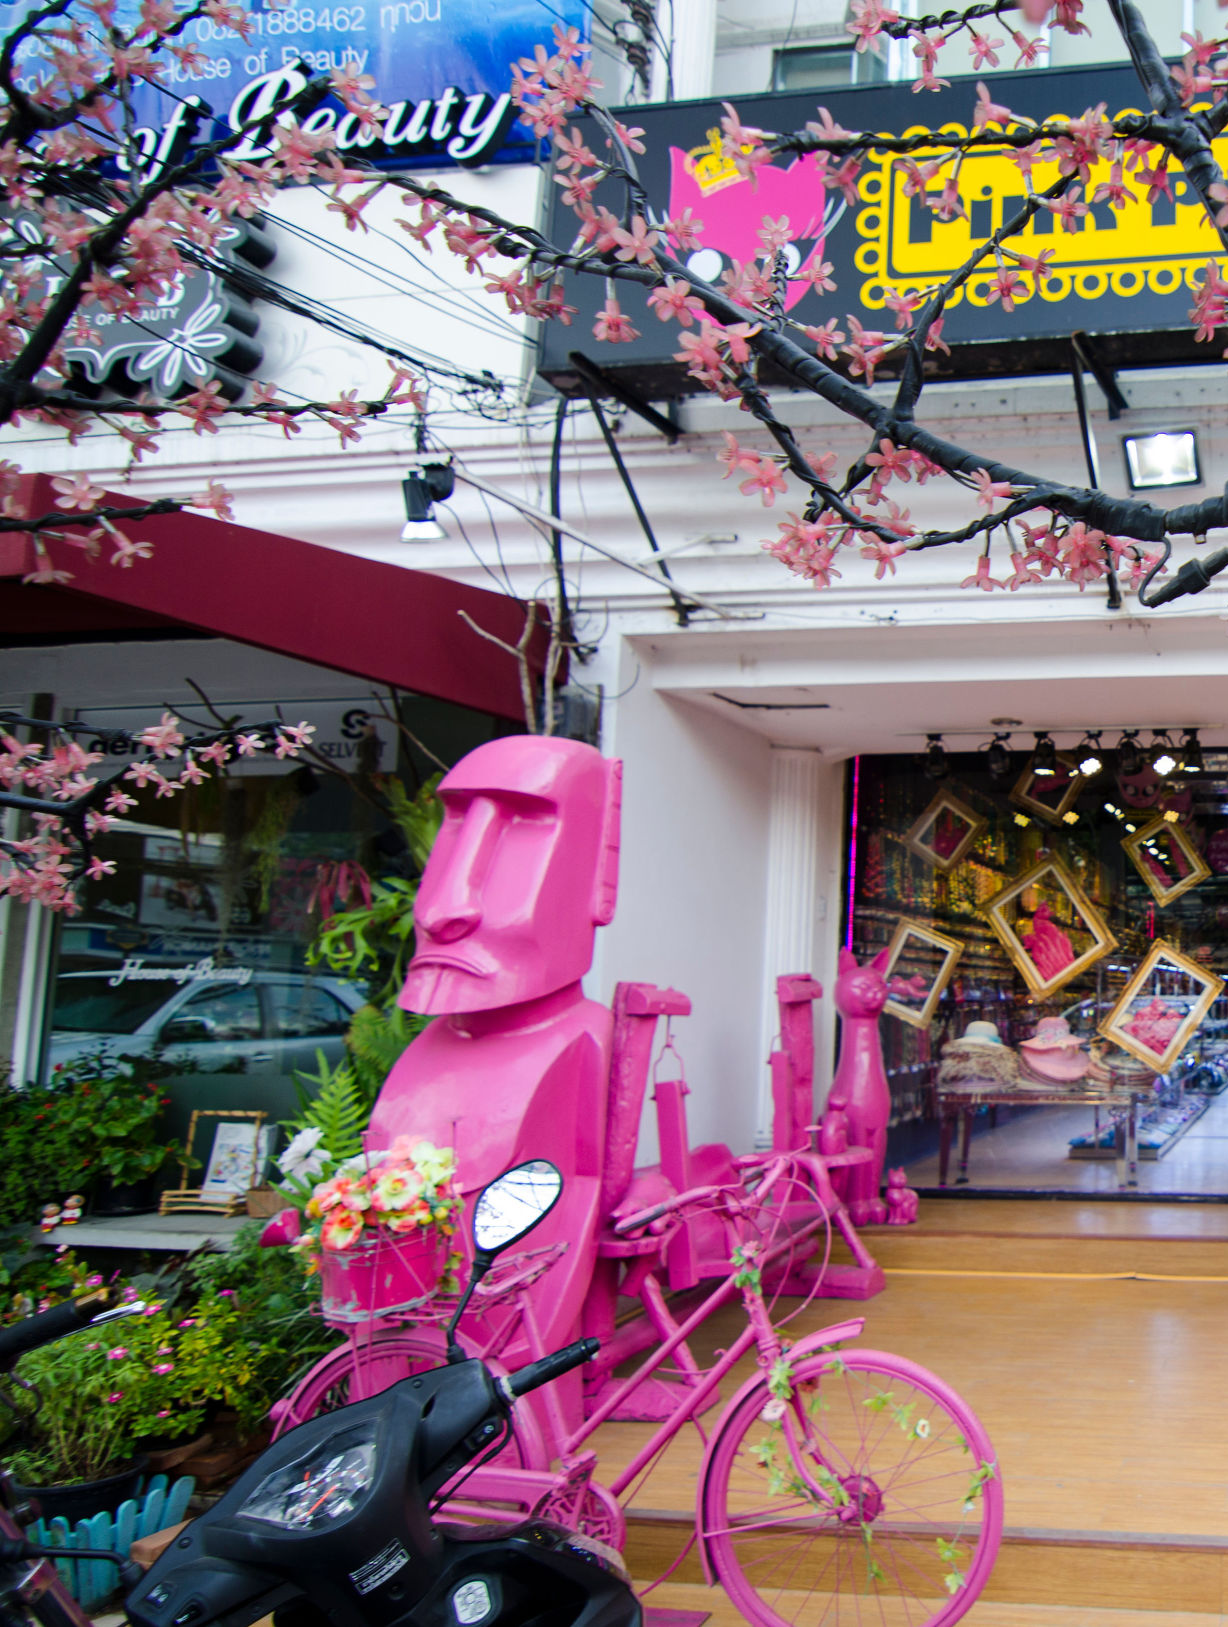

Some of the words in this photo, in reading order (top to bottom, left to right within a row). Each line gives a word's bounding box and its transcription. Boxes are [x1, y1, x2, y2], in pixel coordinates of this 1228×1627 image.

[244, 48, 268, 75] of
[222, 56, 511, 161] Beauty
[319, 741, 387, 759] SELVT
